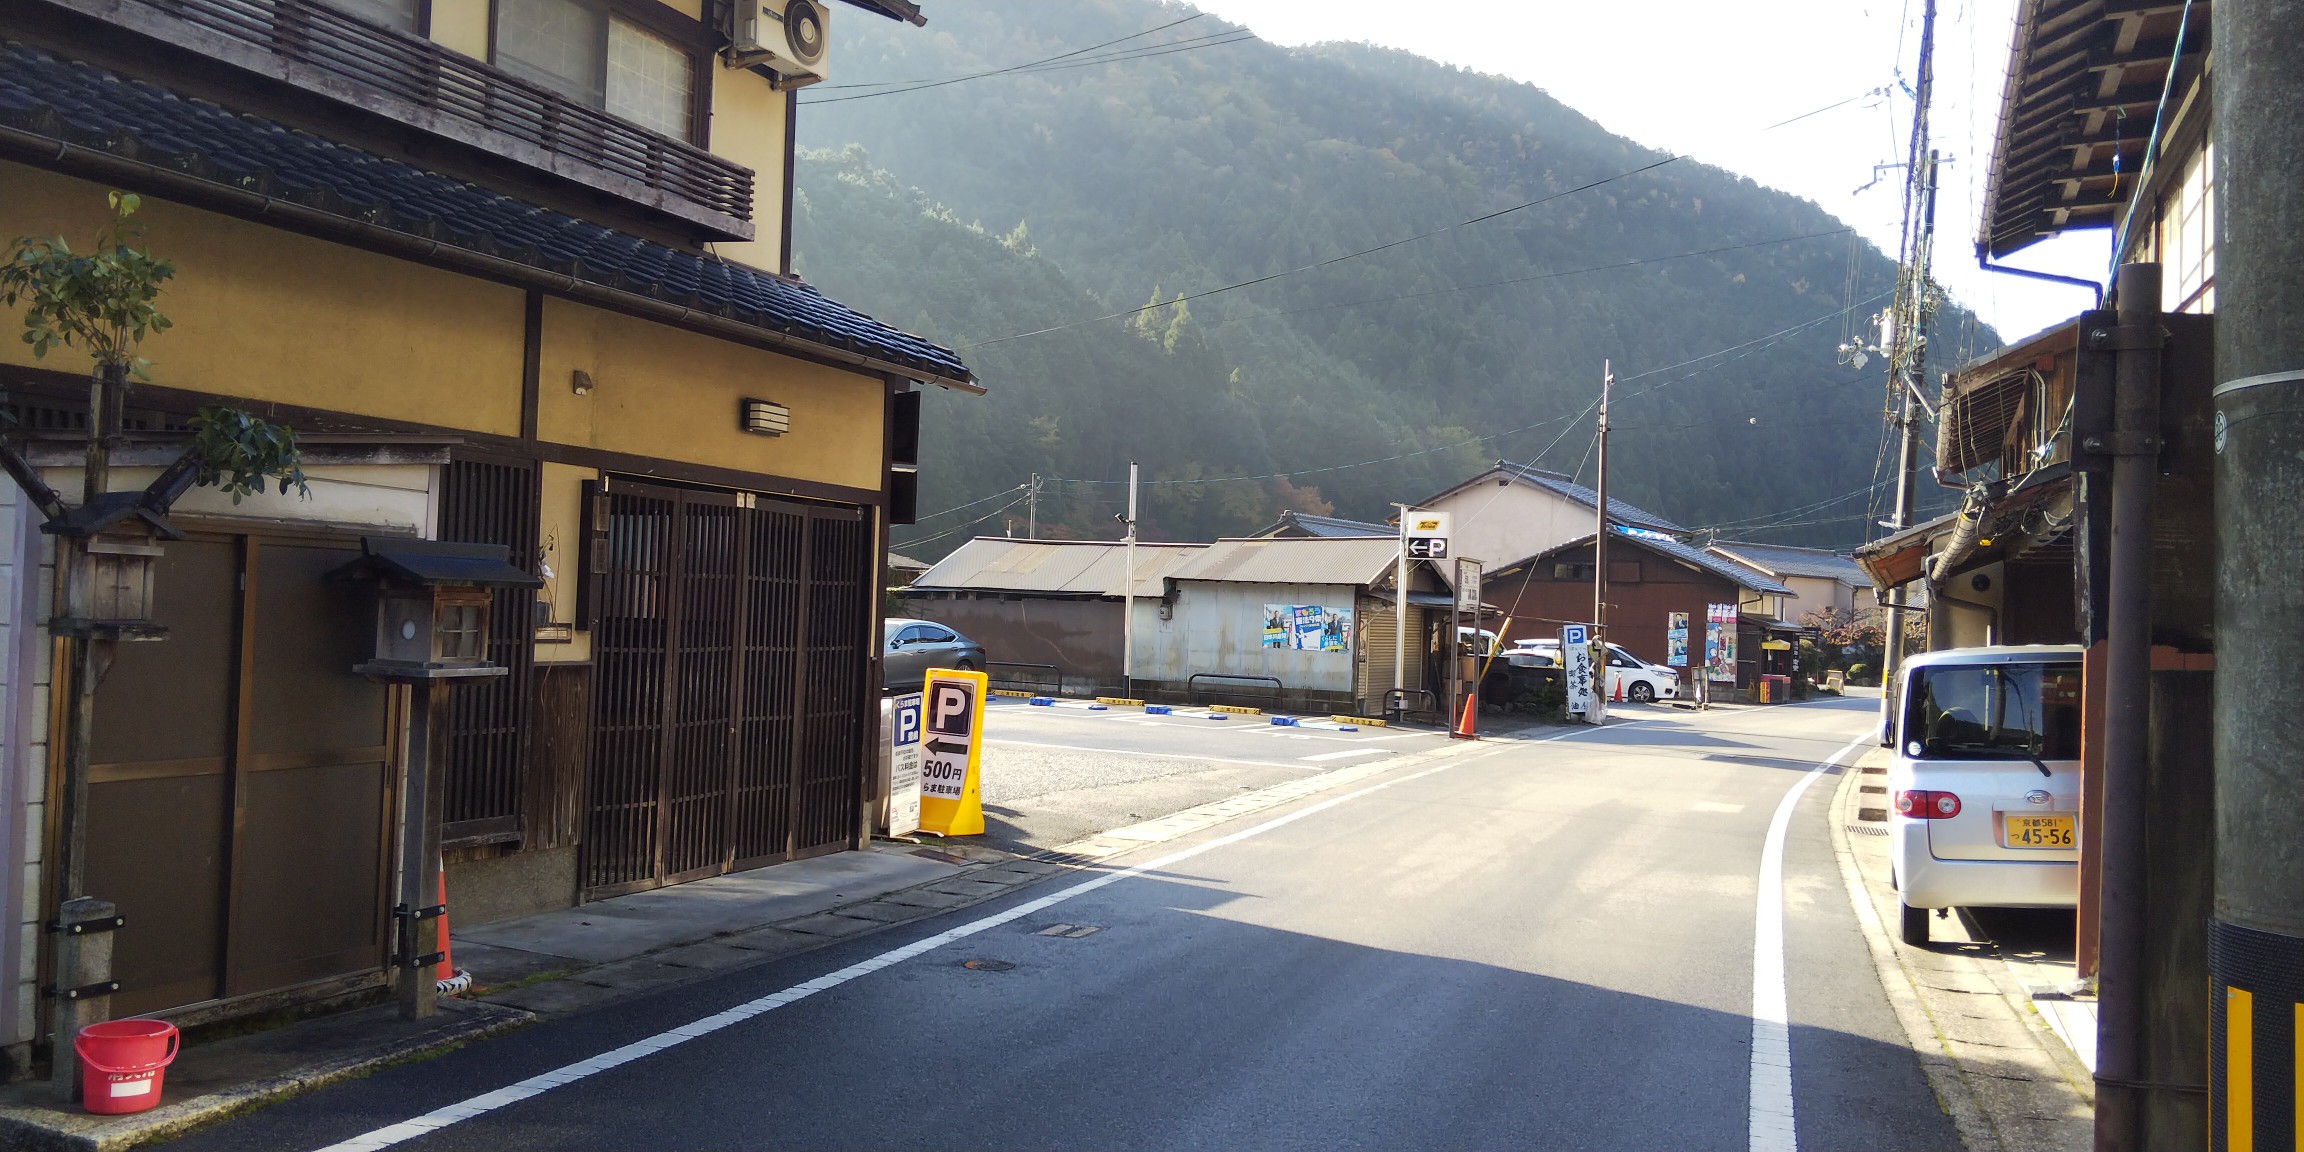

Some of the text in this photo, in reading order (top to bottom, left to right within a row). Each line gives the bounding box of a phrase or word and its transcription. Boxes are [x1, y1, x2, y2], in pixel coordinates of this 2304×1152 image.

[1429, 539, 1446, 558] P
[1569, 630, 1582, 643] P
[1568, 669, 1578, 690] 喫茶
[1576, 652, 1588, 697] お食事処
[936, 687, 966, 729] P
[900, 709, 916, 741] P
[923, 759, 962, 780] 500円
[923, 782, 961, 796] らま駐車場
[2022, 829, 2071, 845] 45-56
